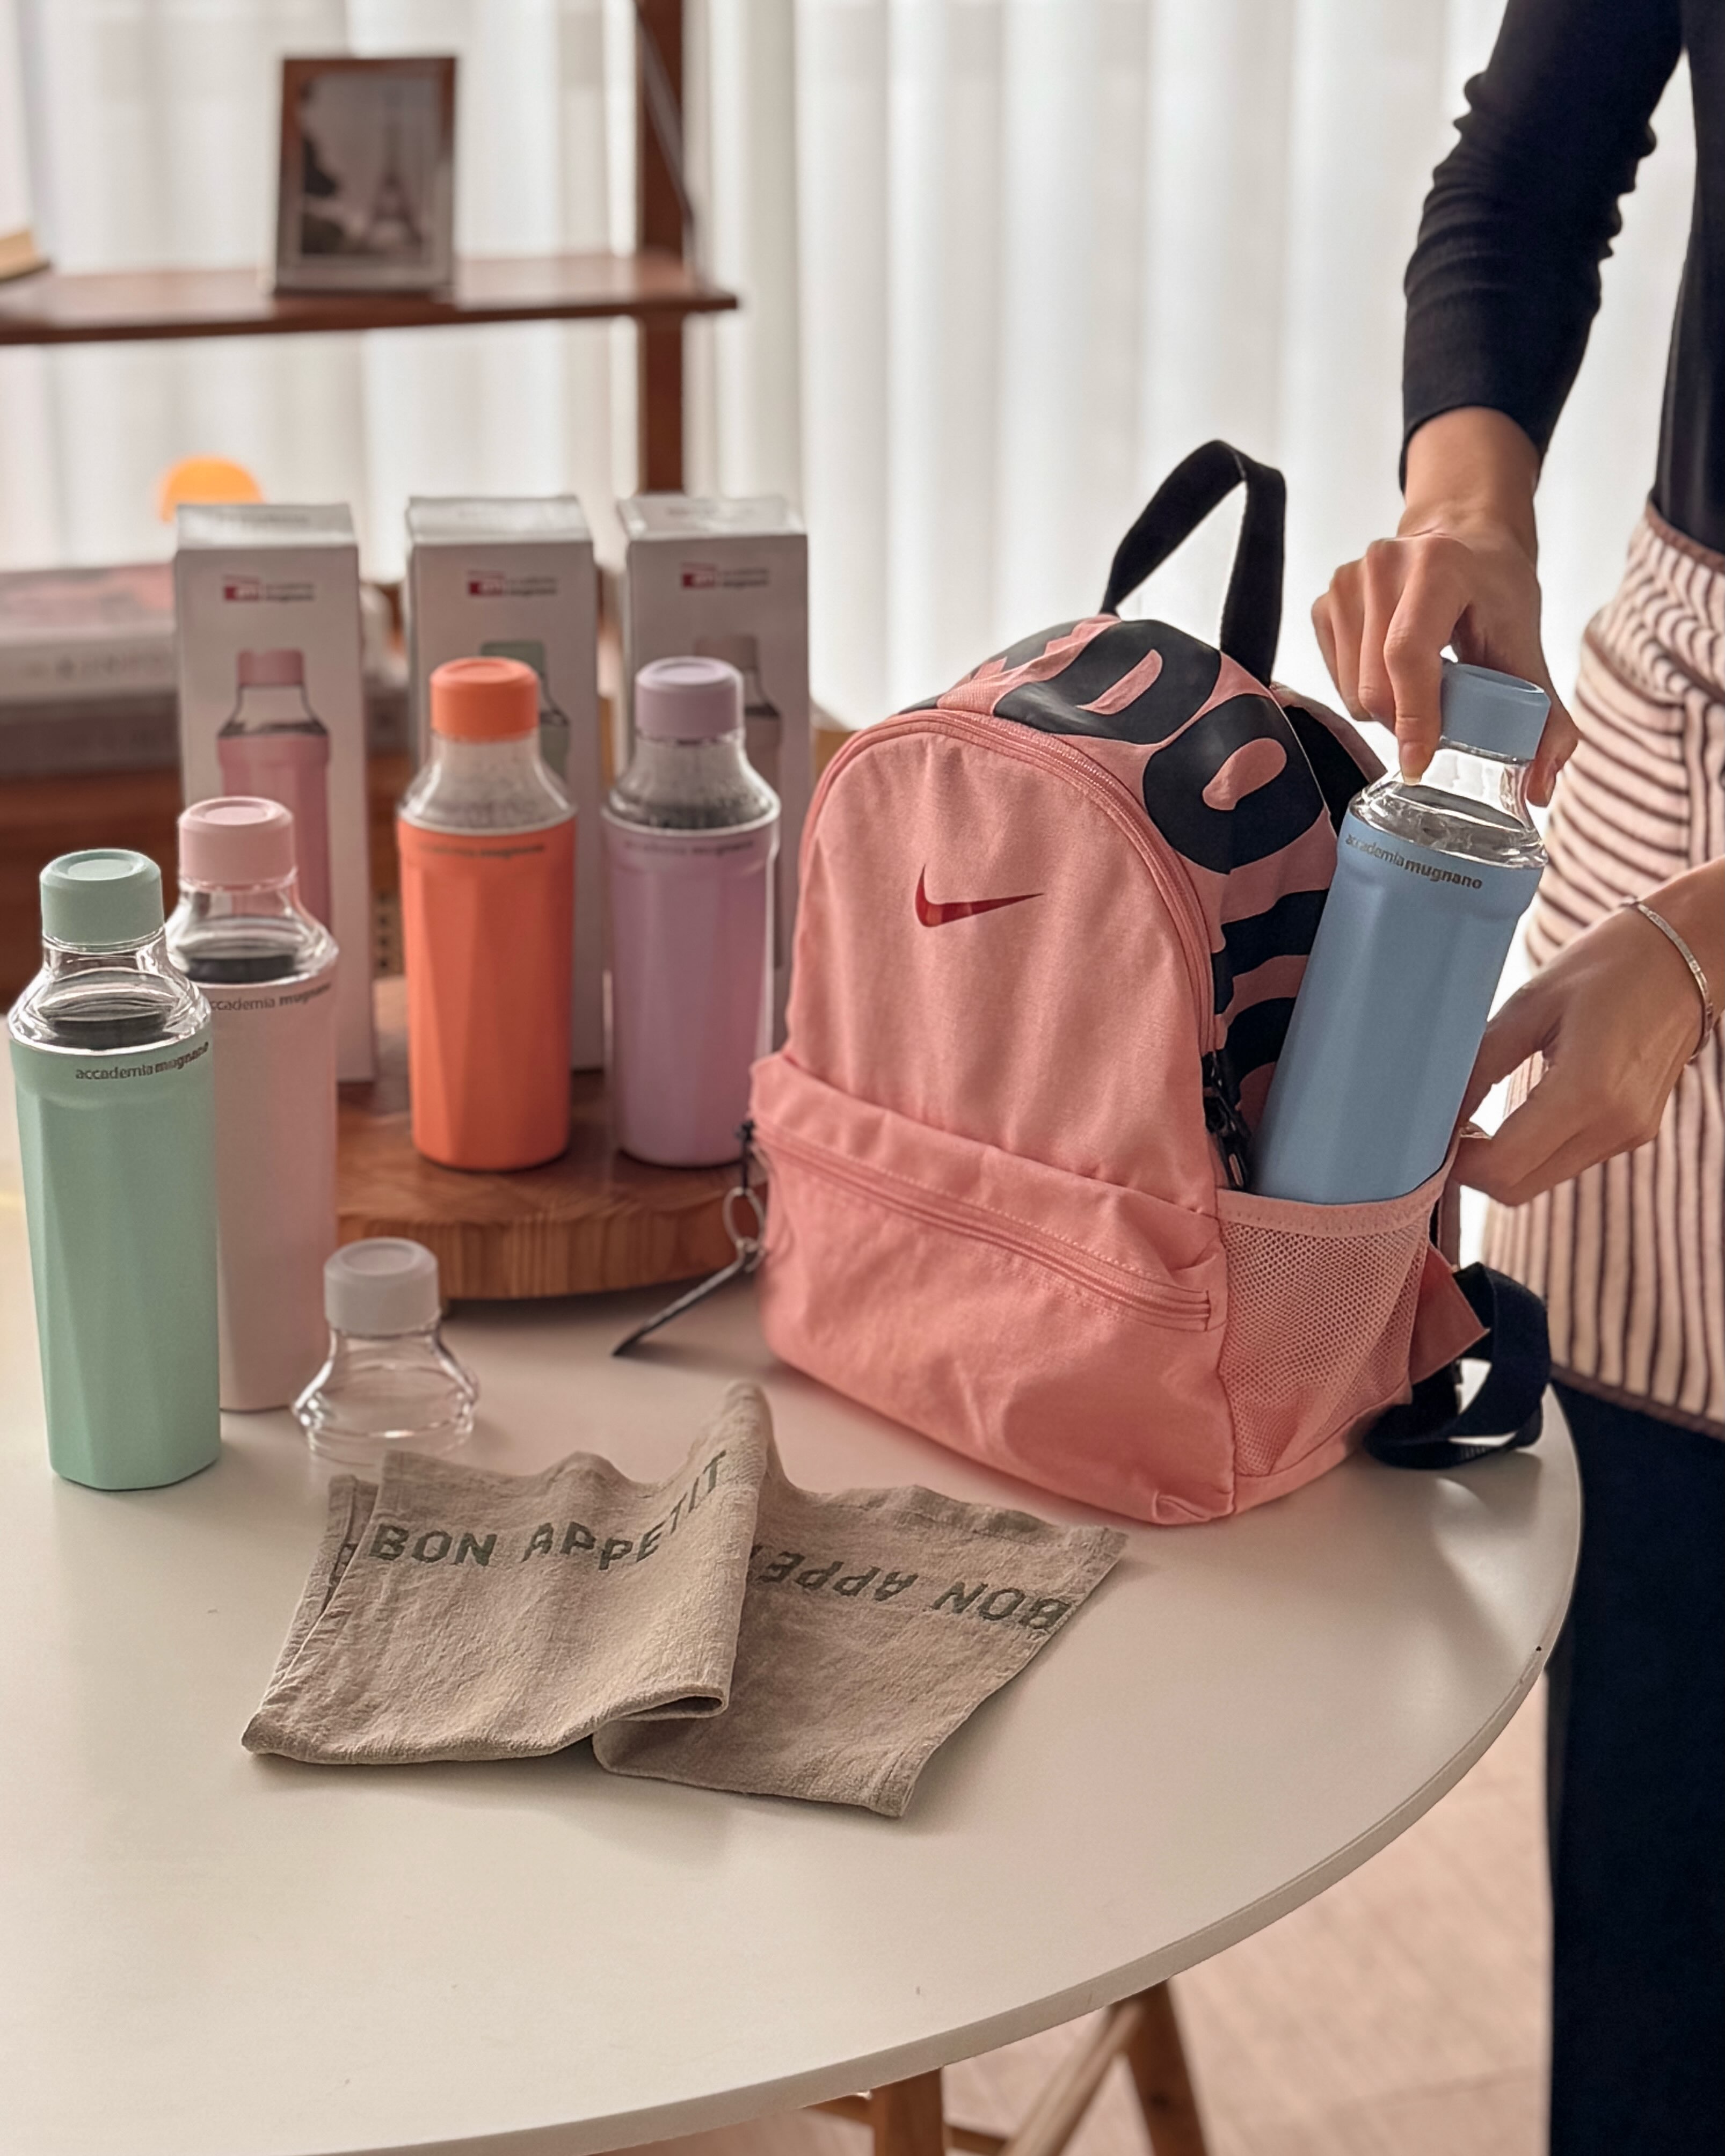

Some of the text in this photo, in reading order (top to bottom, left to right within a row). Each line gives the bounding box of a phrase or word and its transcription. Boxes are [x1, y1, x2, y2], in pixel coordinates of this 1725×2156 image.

[1404, 859, 1482, 890] mugnano
[210, 997, 276, 1010] ccademia
[76, 1065, 153, 1080] accademia
[369, 1523, 498, 1567] BON
[521, 1450, 726, 1571] APPETIT
[748, 1544, 1074, 1630] BON APPE
